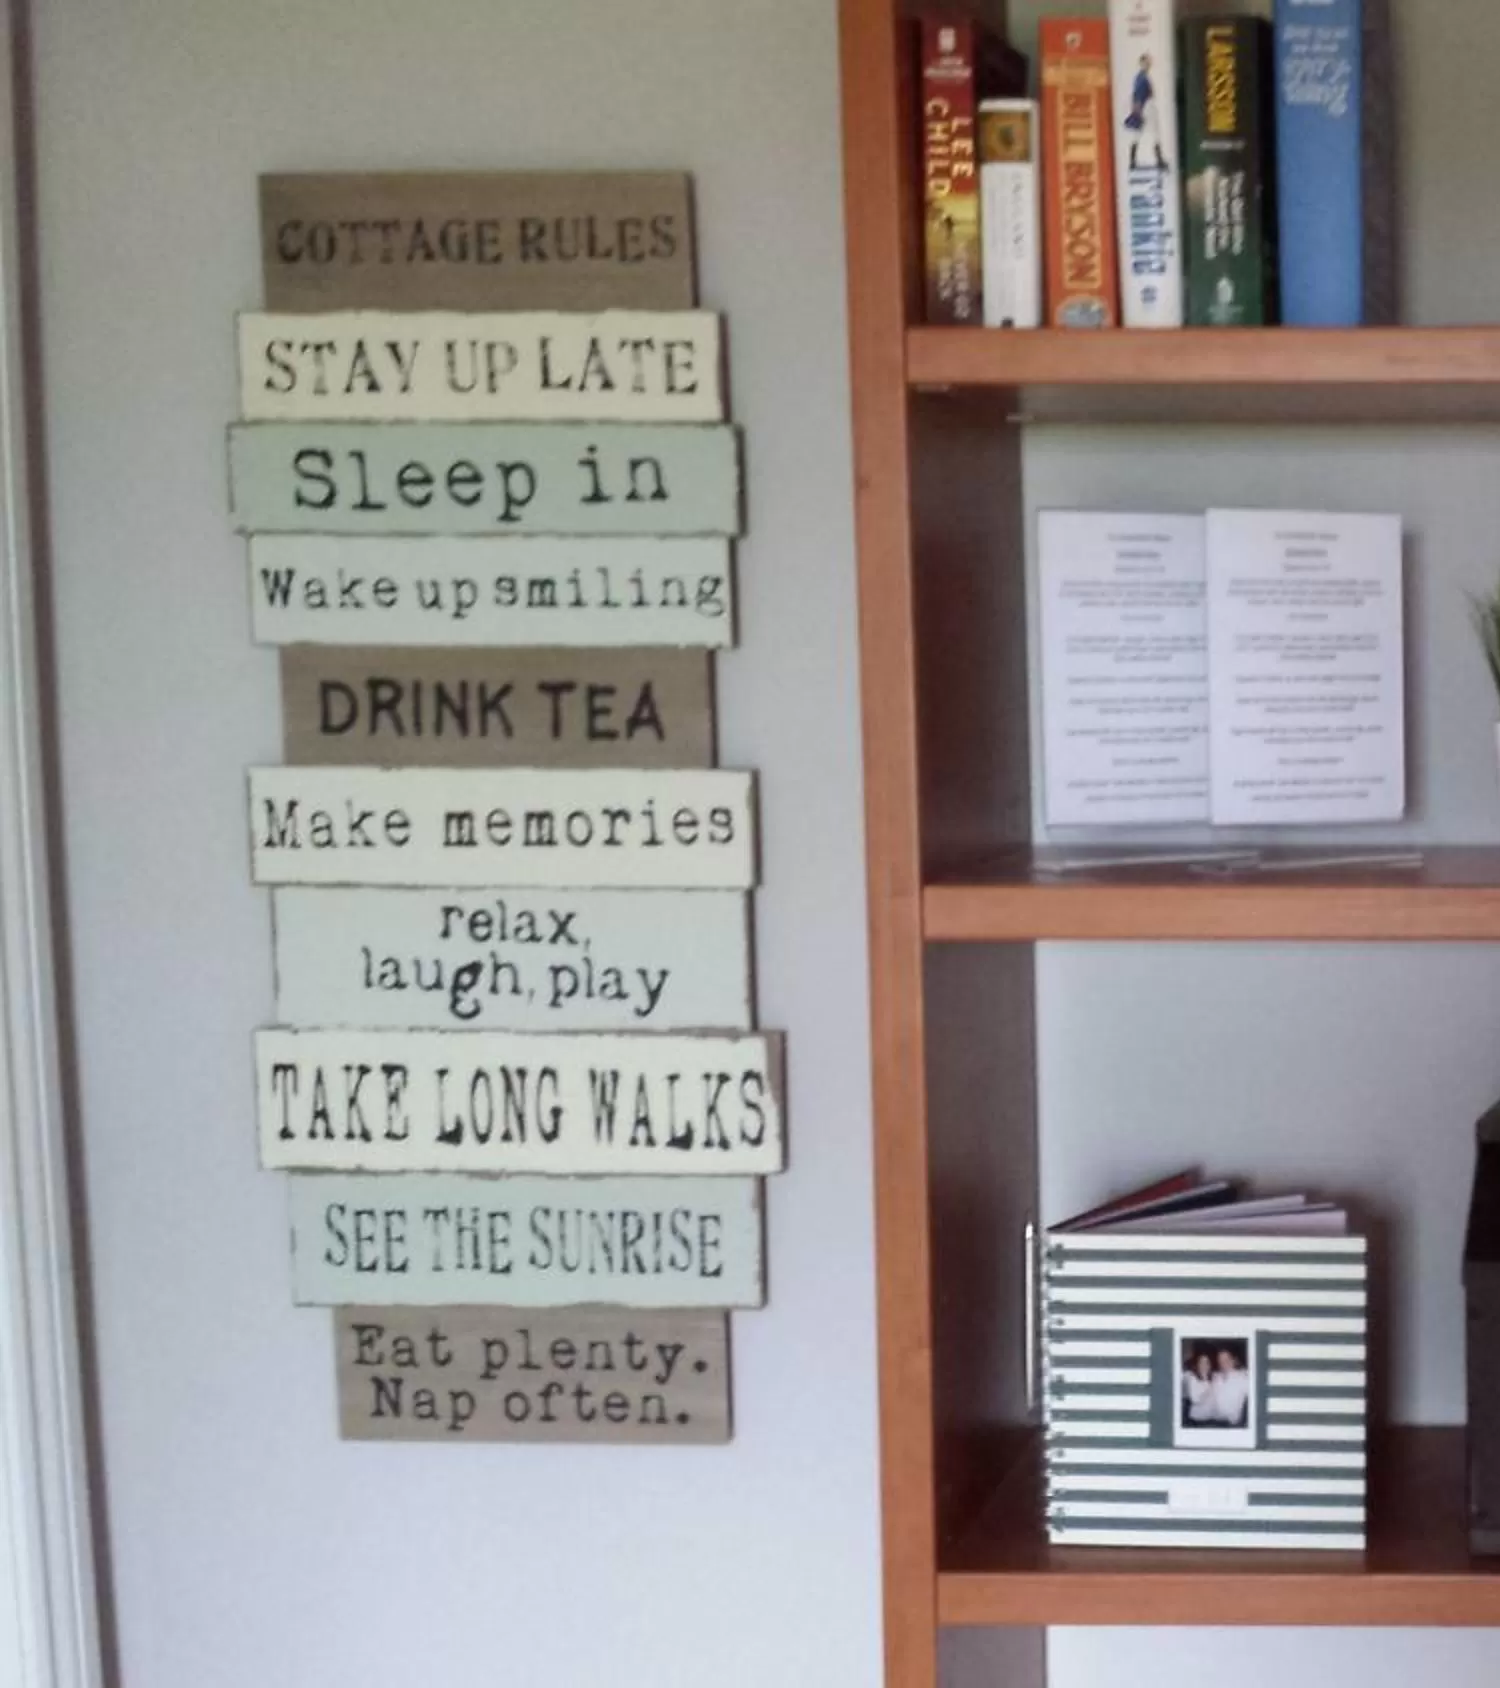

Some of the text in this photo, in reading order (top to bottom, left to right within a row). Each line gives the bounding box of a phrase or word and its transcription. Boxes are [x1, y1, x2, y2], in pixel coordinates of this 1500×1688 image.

[1206, 25, 1238, 133] LARSSON
[926, 96, 951, 200] CHILD
[951, 116, 975, 179] LEE
[1062, 92, 1098, 286] BILL BRYSON
[275, 213, 678, 267] COTTAGE RULES
[263, 335, 700, 395] STAY UP LATE
[292, 444, 671, 524] Sleep in
[260, 566, 726, 619] Wake up smiling
[318, 676, 667, 741] DRINK TEA
[262, 797, 737, 850] Make memories
[439, 899, 593, 950] relax,
[271, 1062, 768, 1151] TAKE LONG WALKS
[325, 1202, 724, 1280] SEE THE SUNRISE
[351, 1322, 709, 1382] Eat plenty.
[370, 1377, 692, 1431] Nap often.
